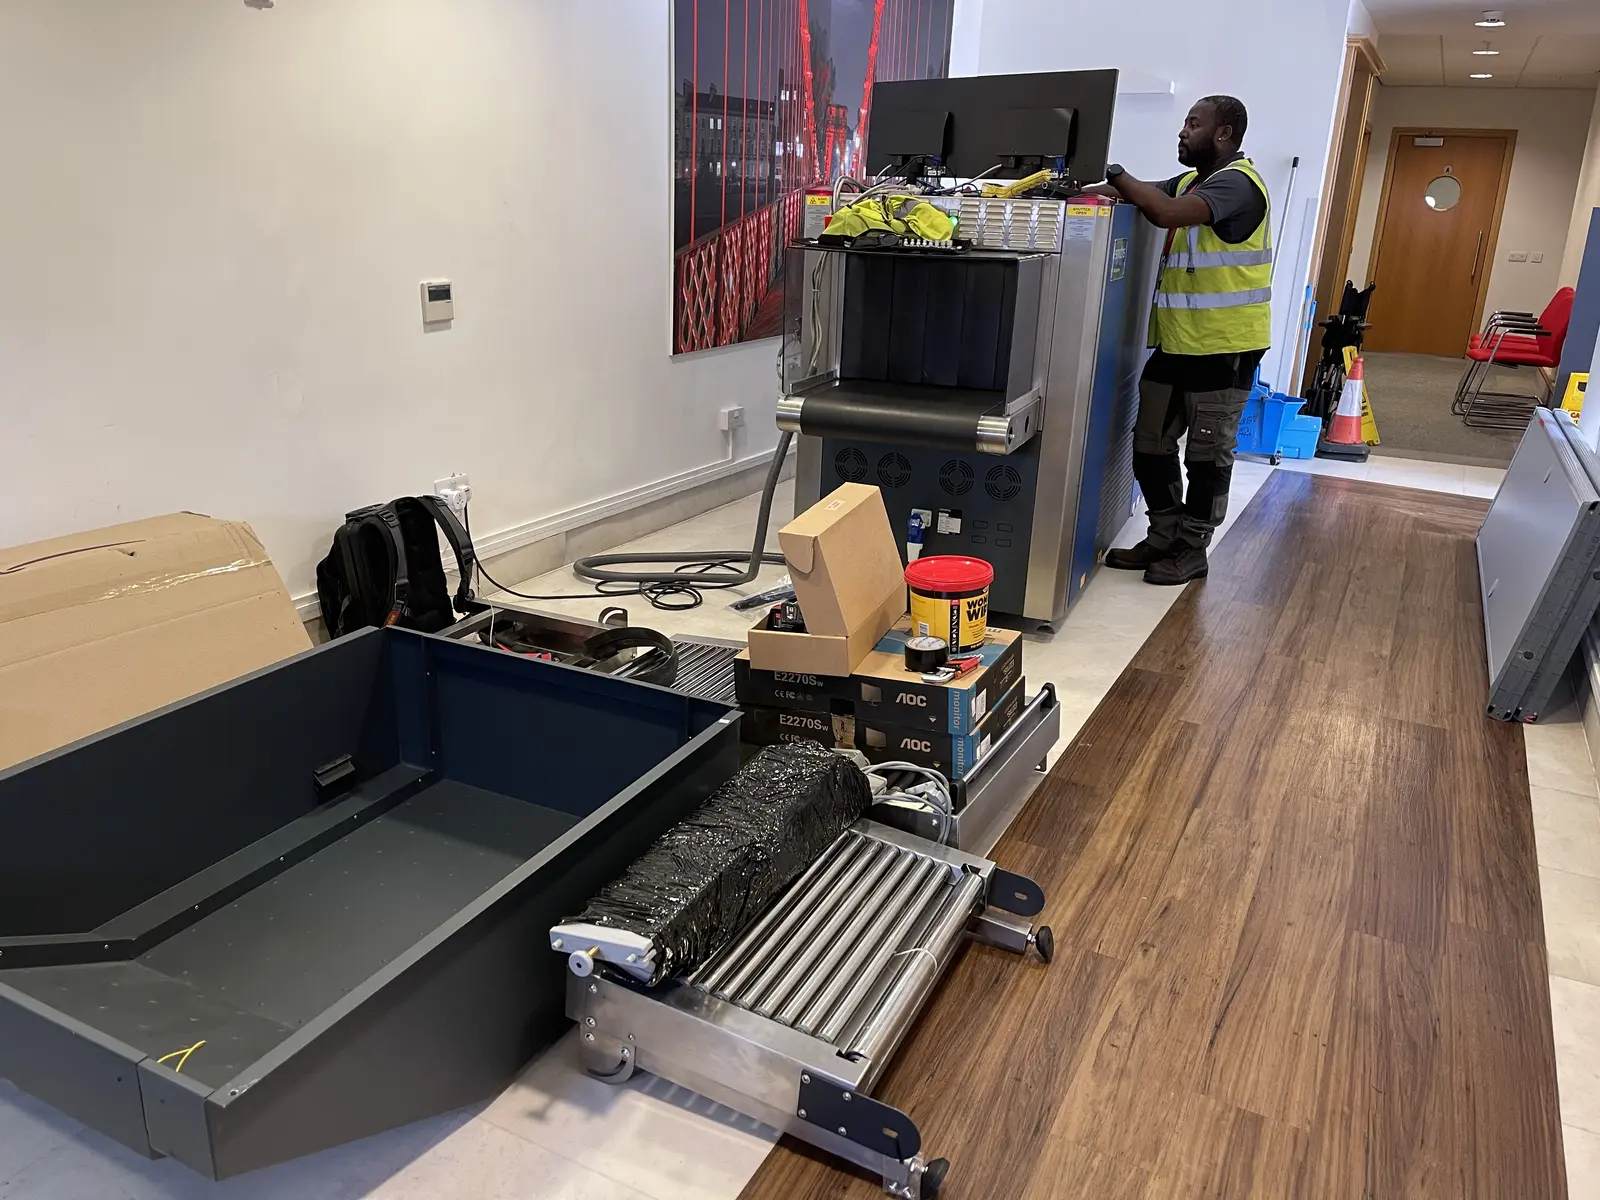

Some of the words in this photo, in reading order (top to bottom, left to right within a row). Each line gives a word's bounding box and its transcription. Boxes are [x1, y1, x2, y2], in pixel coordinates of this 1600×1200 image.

[895, 692, 927, 707] AOC
[953, 690, 962, 730] monitor
[900, 738, 931, 753] AOC
[957, 737, 966, 776] monitor
